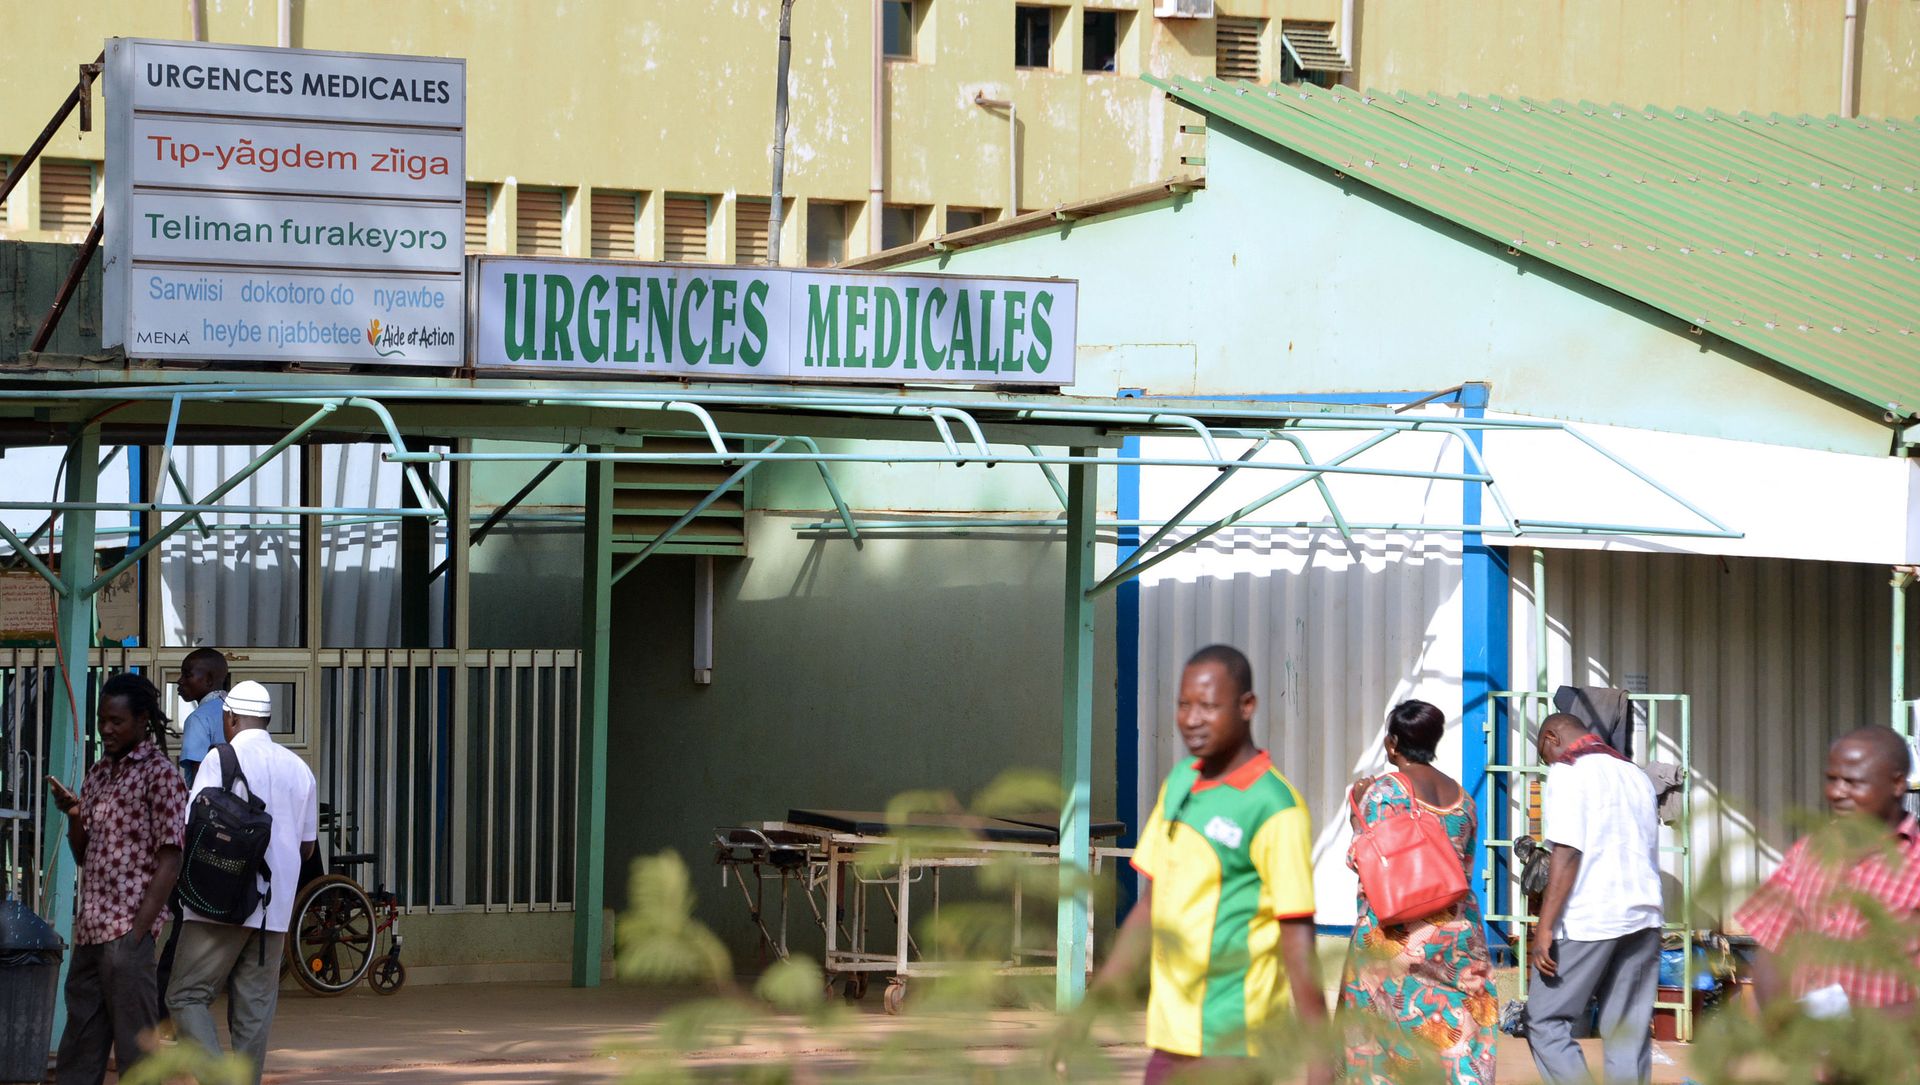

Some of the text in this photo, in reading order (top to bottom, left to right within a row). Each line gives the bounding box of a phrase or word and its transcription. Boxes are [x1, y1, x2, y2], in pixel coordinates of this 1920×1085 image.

[147, 63, 450, 104] URGENCES MEDICALES
[145, 213, 273, 243] Teliman
[150, 276, 223, 301] Sarwiisi
[241, 280, 325, 305] dokotoro
[382, 324, 455, 348] Aide et Action
[504, 272, 1054, 374] URGENCES MEDICALES
